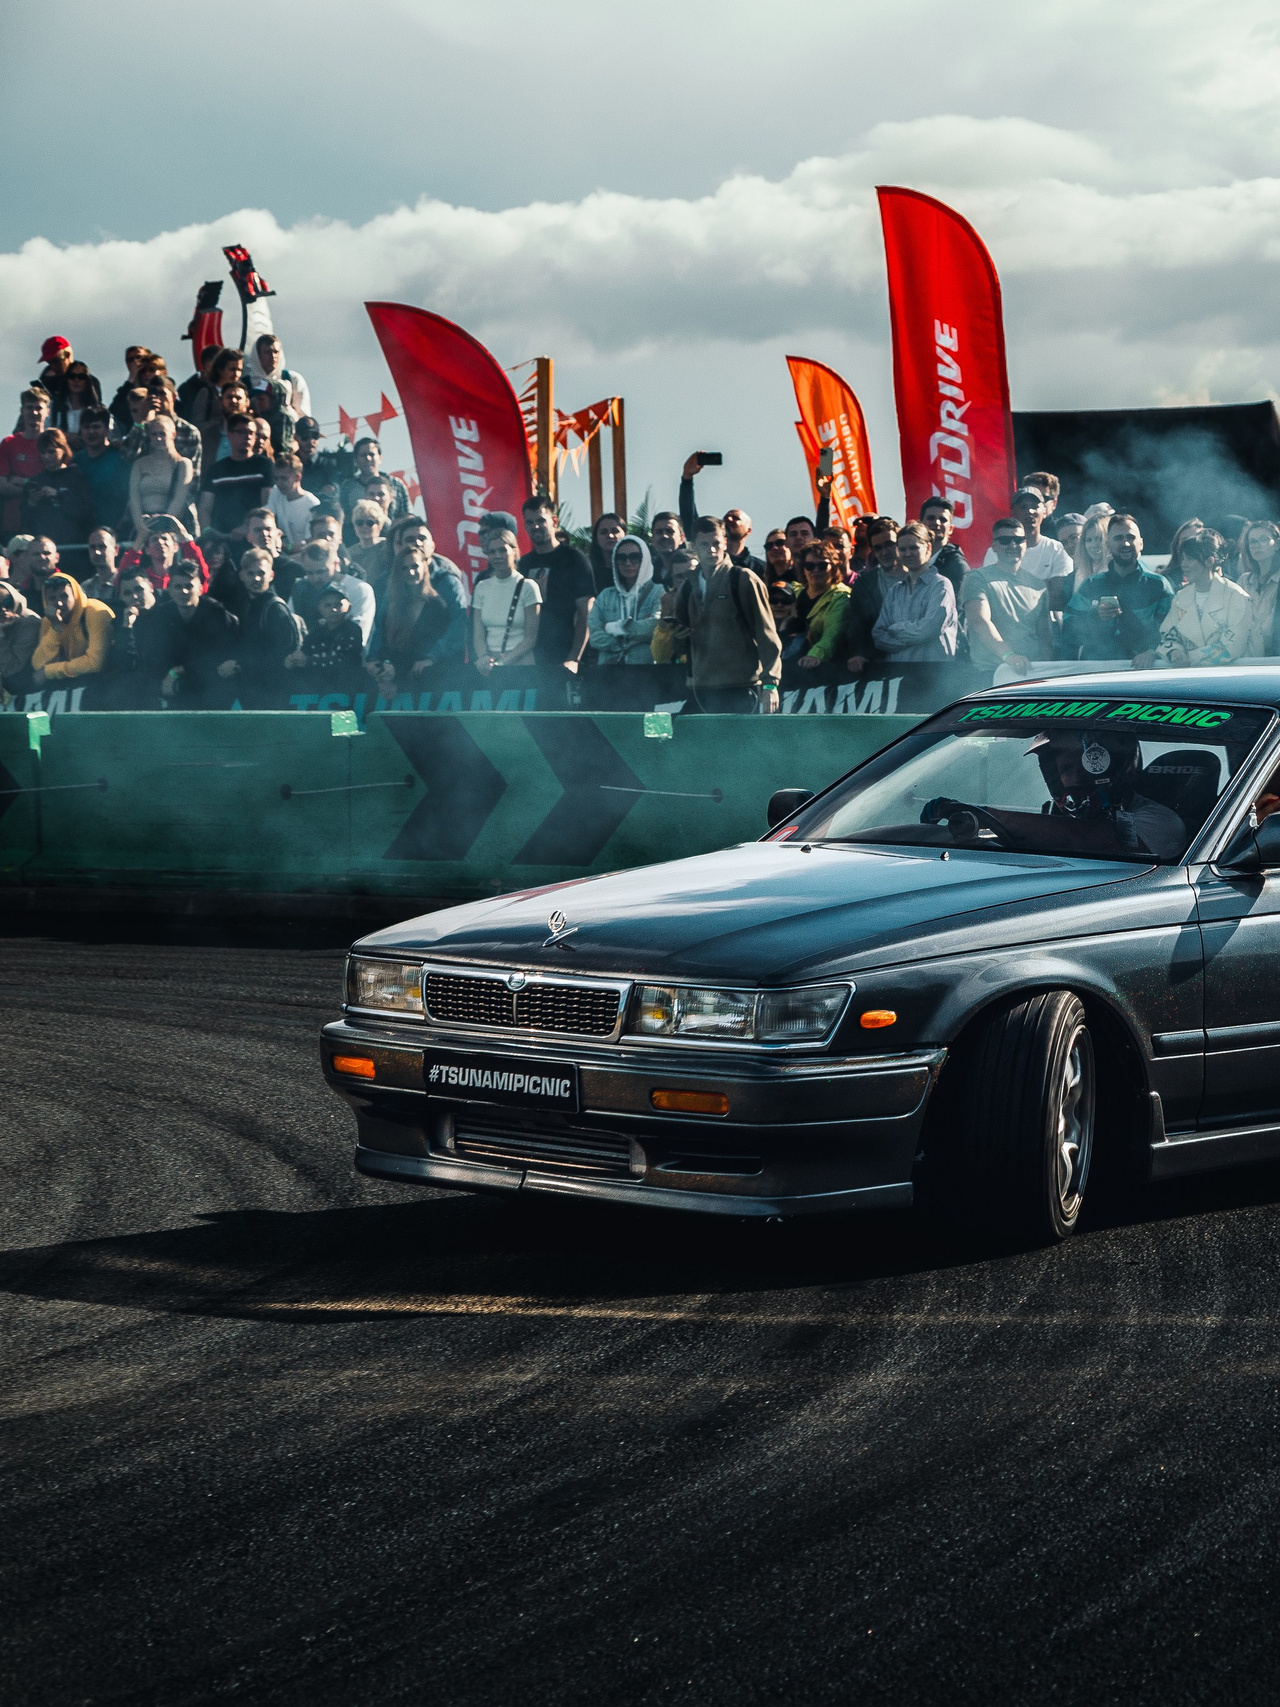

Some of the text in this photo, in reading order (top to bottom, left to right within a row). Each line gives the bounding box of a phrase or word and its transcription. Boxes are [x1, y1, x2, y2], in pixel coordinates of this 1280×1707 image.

[957, 702, 1232, 728] TSUNAMI PICNIC
[428, 1064, 571, 1098] #TSUNAMIPICNIC
